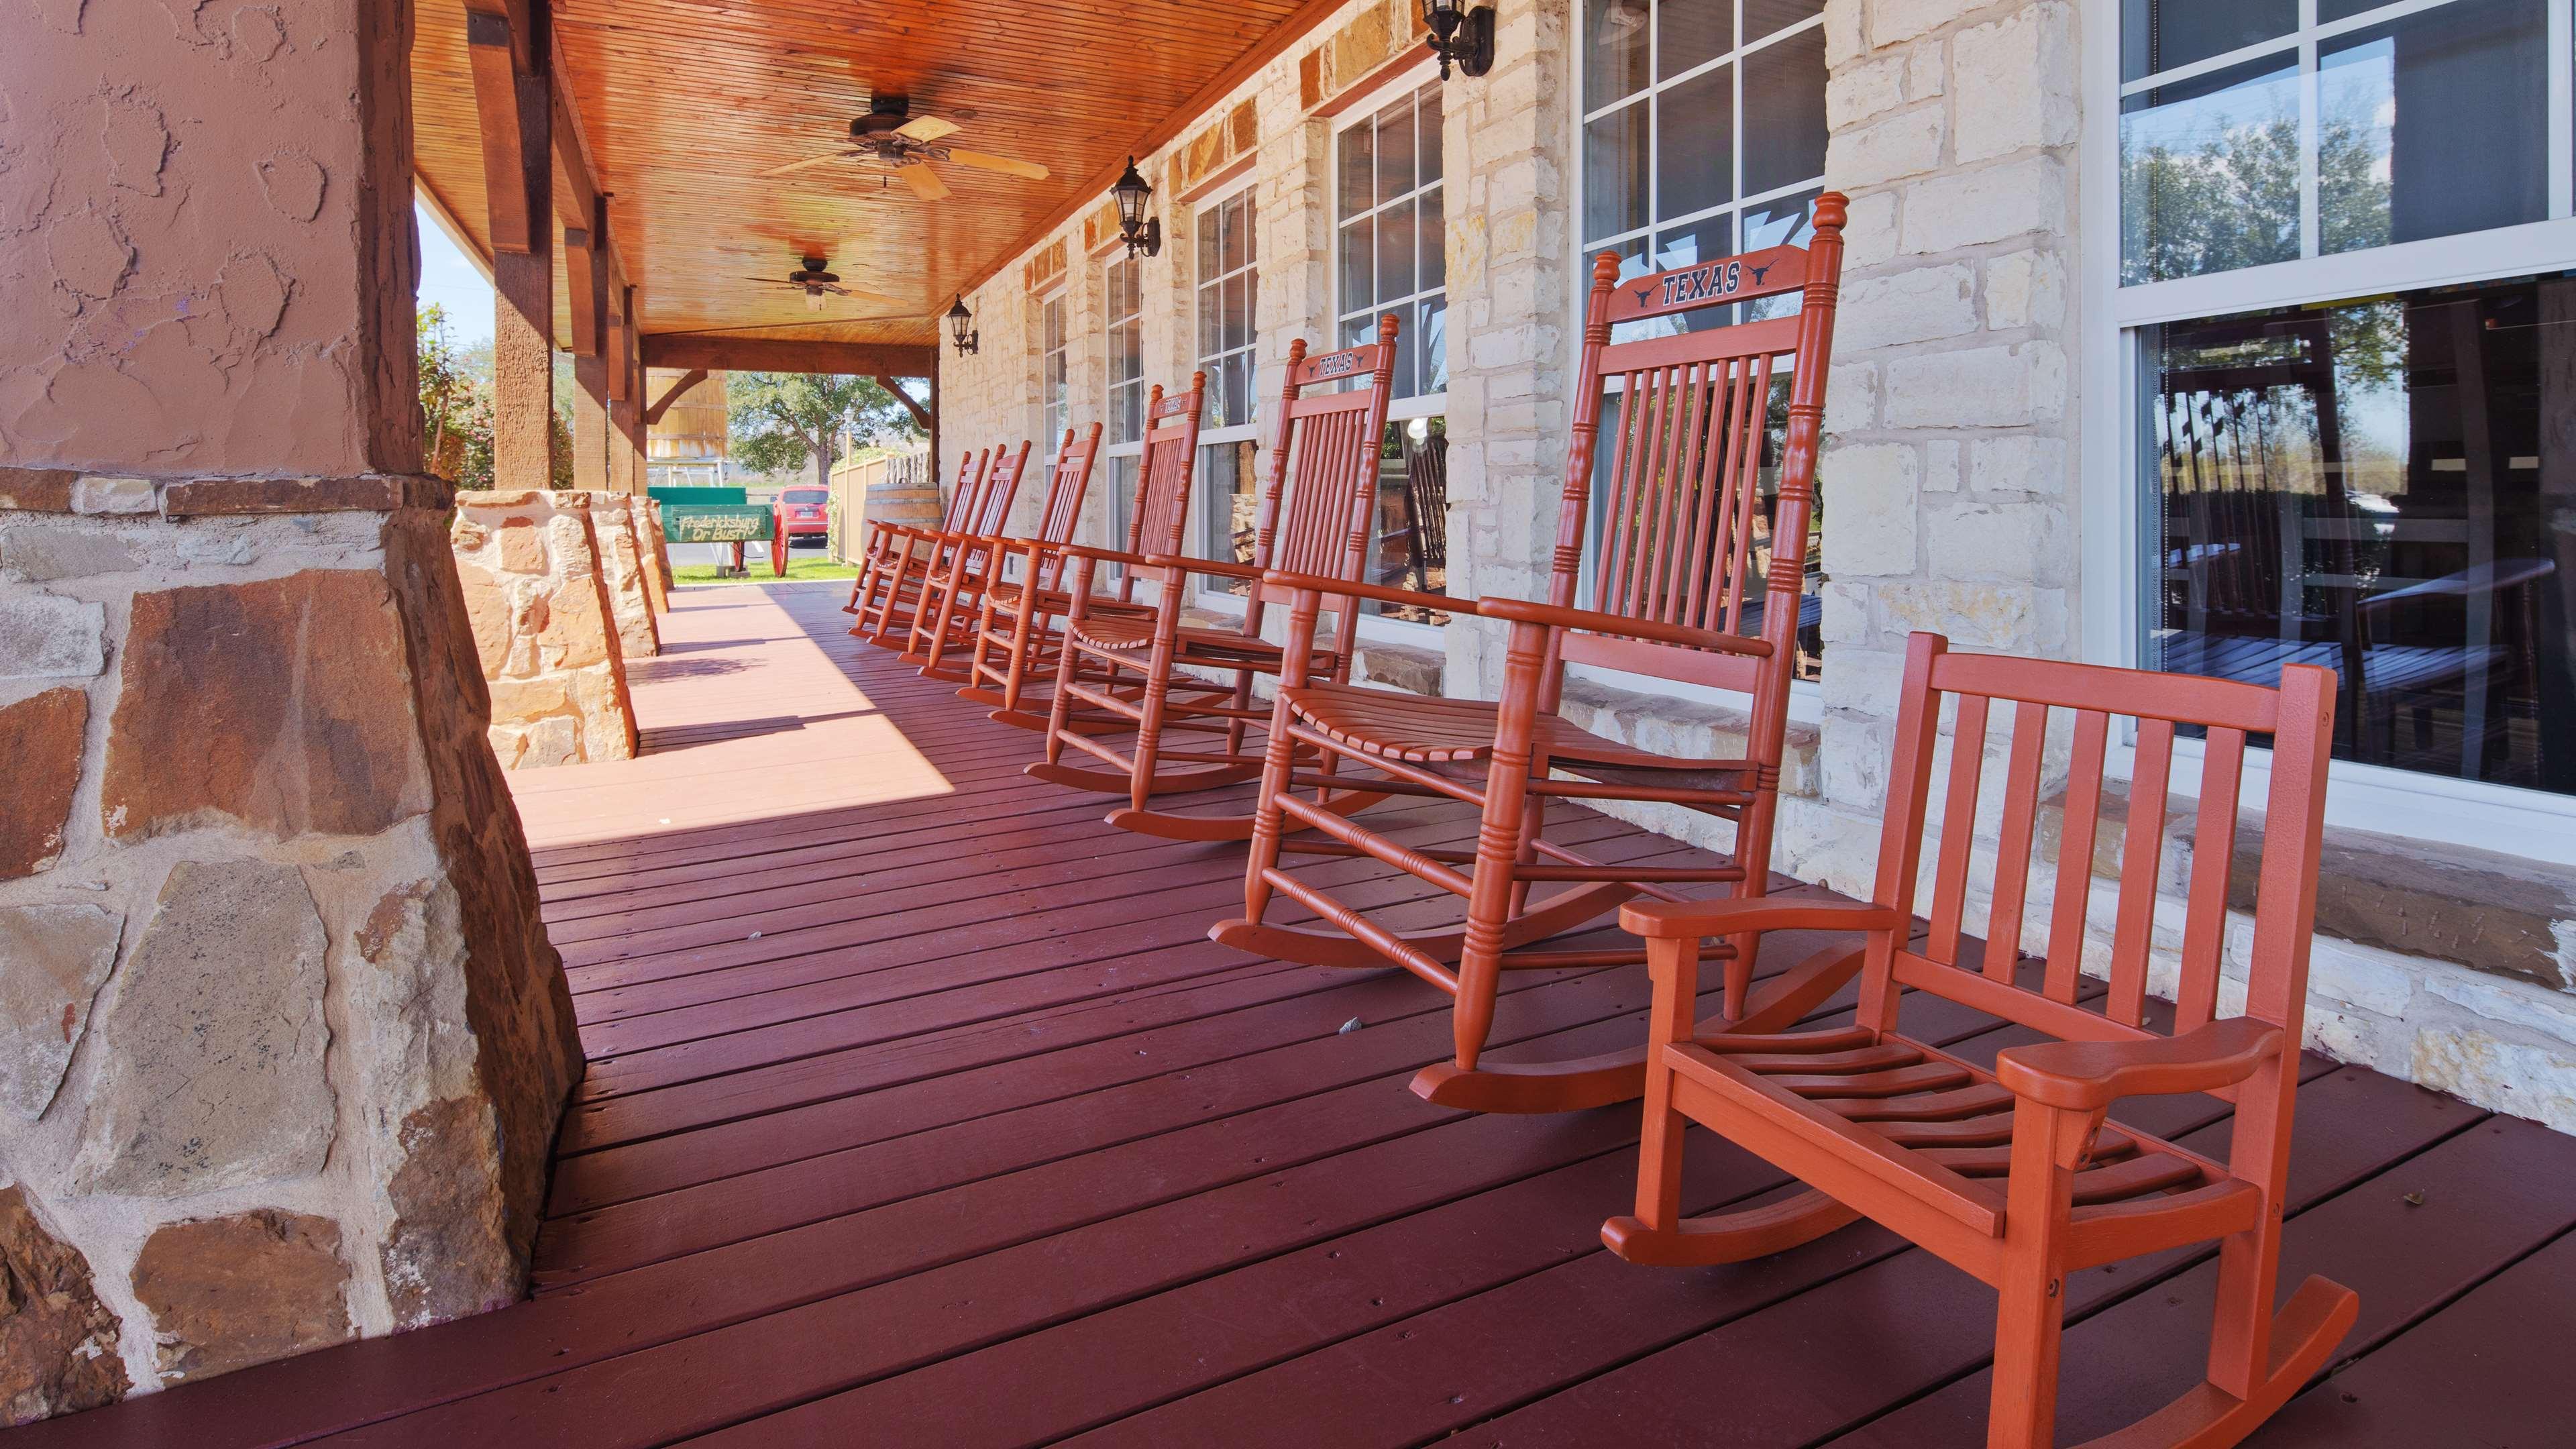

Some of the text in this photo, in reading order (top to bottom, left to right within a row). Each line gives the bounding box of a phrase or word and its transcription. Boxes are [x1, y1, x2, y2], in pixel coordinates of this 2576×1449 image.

[1662, 261, 1741, 306] TEXAS
[1320, 352, 1353, 376] TEXAS
[692, 528, 710, 541] Or
